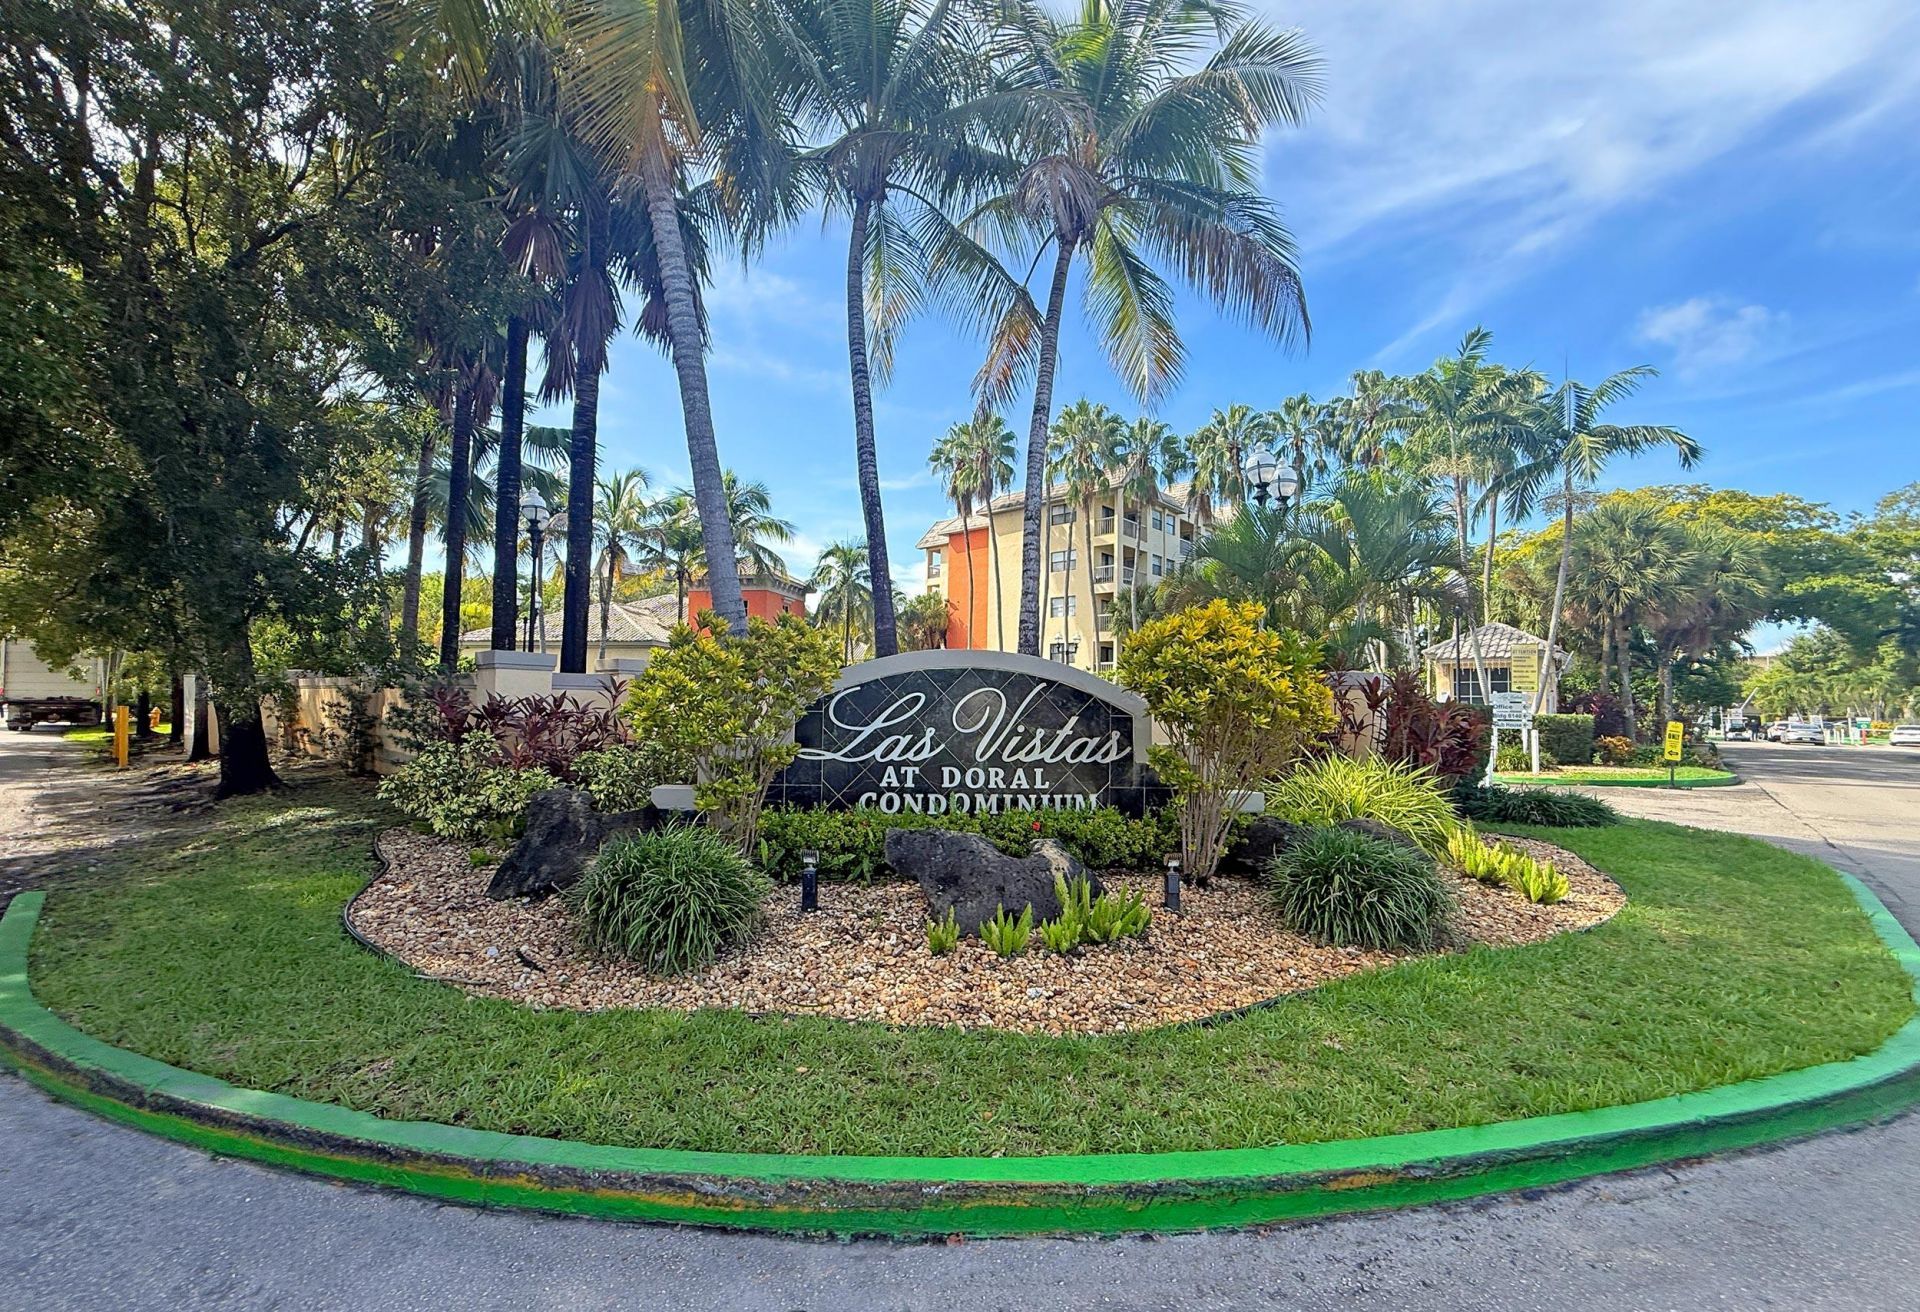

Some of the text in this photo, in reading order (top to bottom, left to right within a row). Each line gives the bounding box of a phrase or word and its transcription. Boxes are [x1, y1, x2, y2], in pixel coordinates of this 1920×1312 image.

[797, 682, 1132, 764] Las Vistas
[879, 767, 1050, 789] AT DORAL
[859, 791, 1098, 815] CONDOMINIUM
